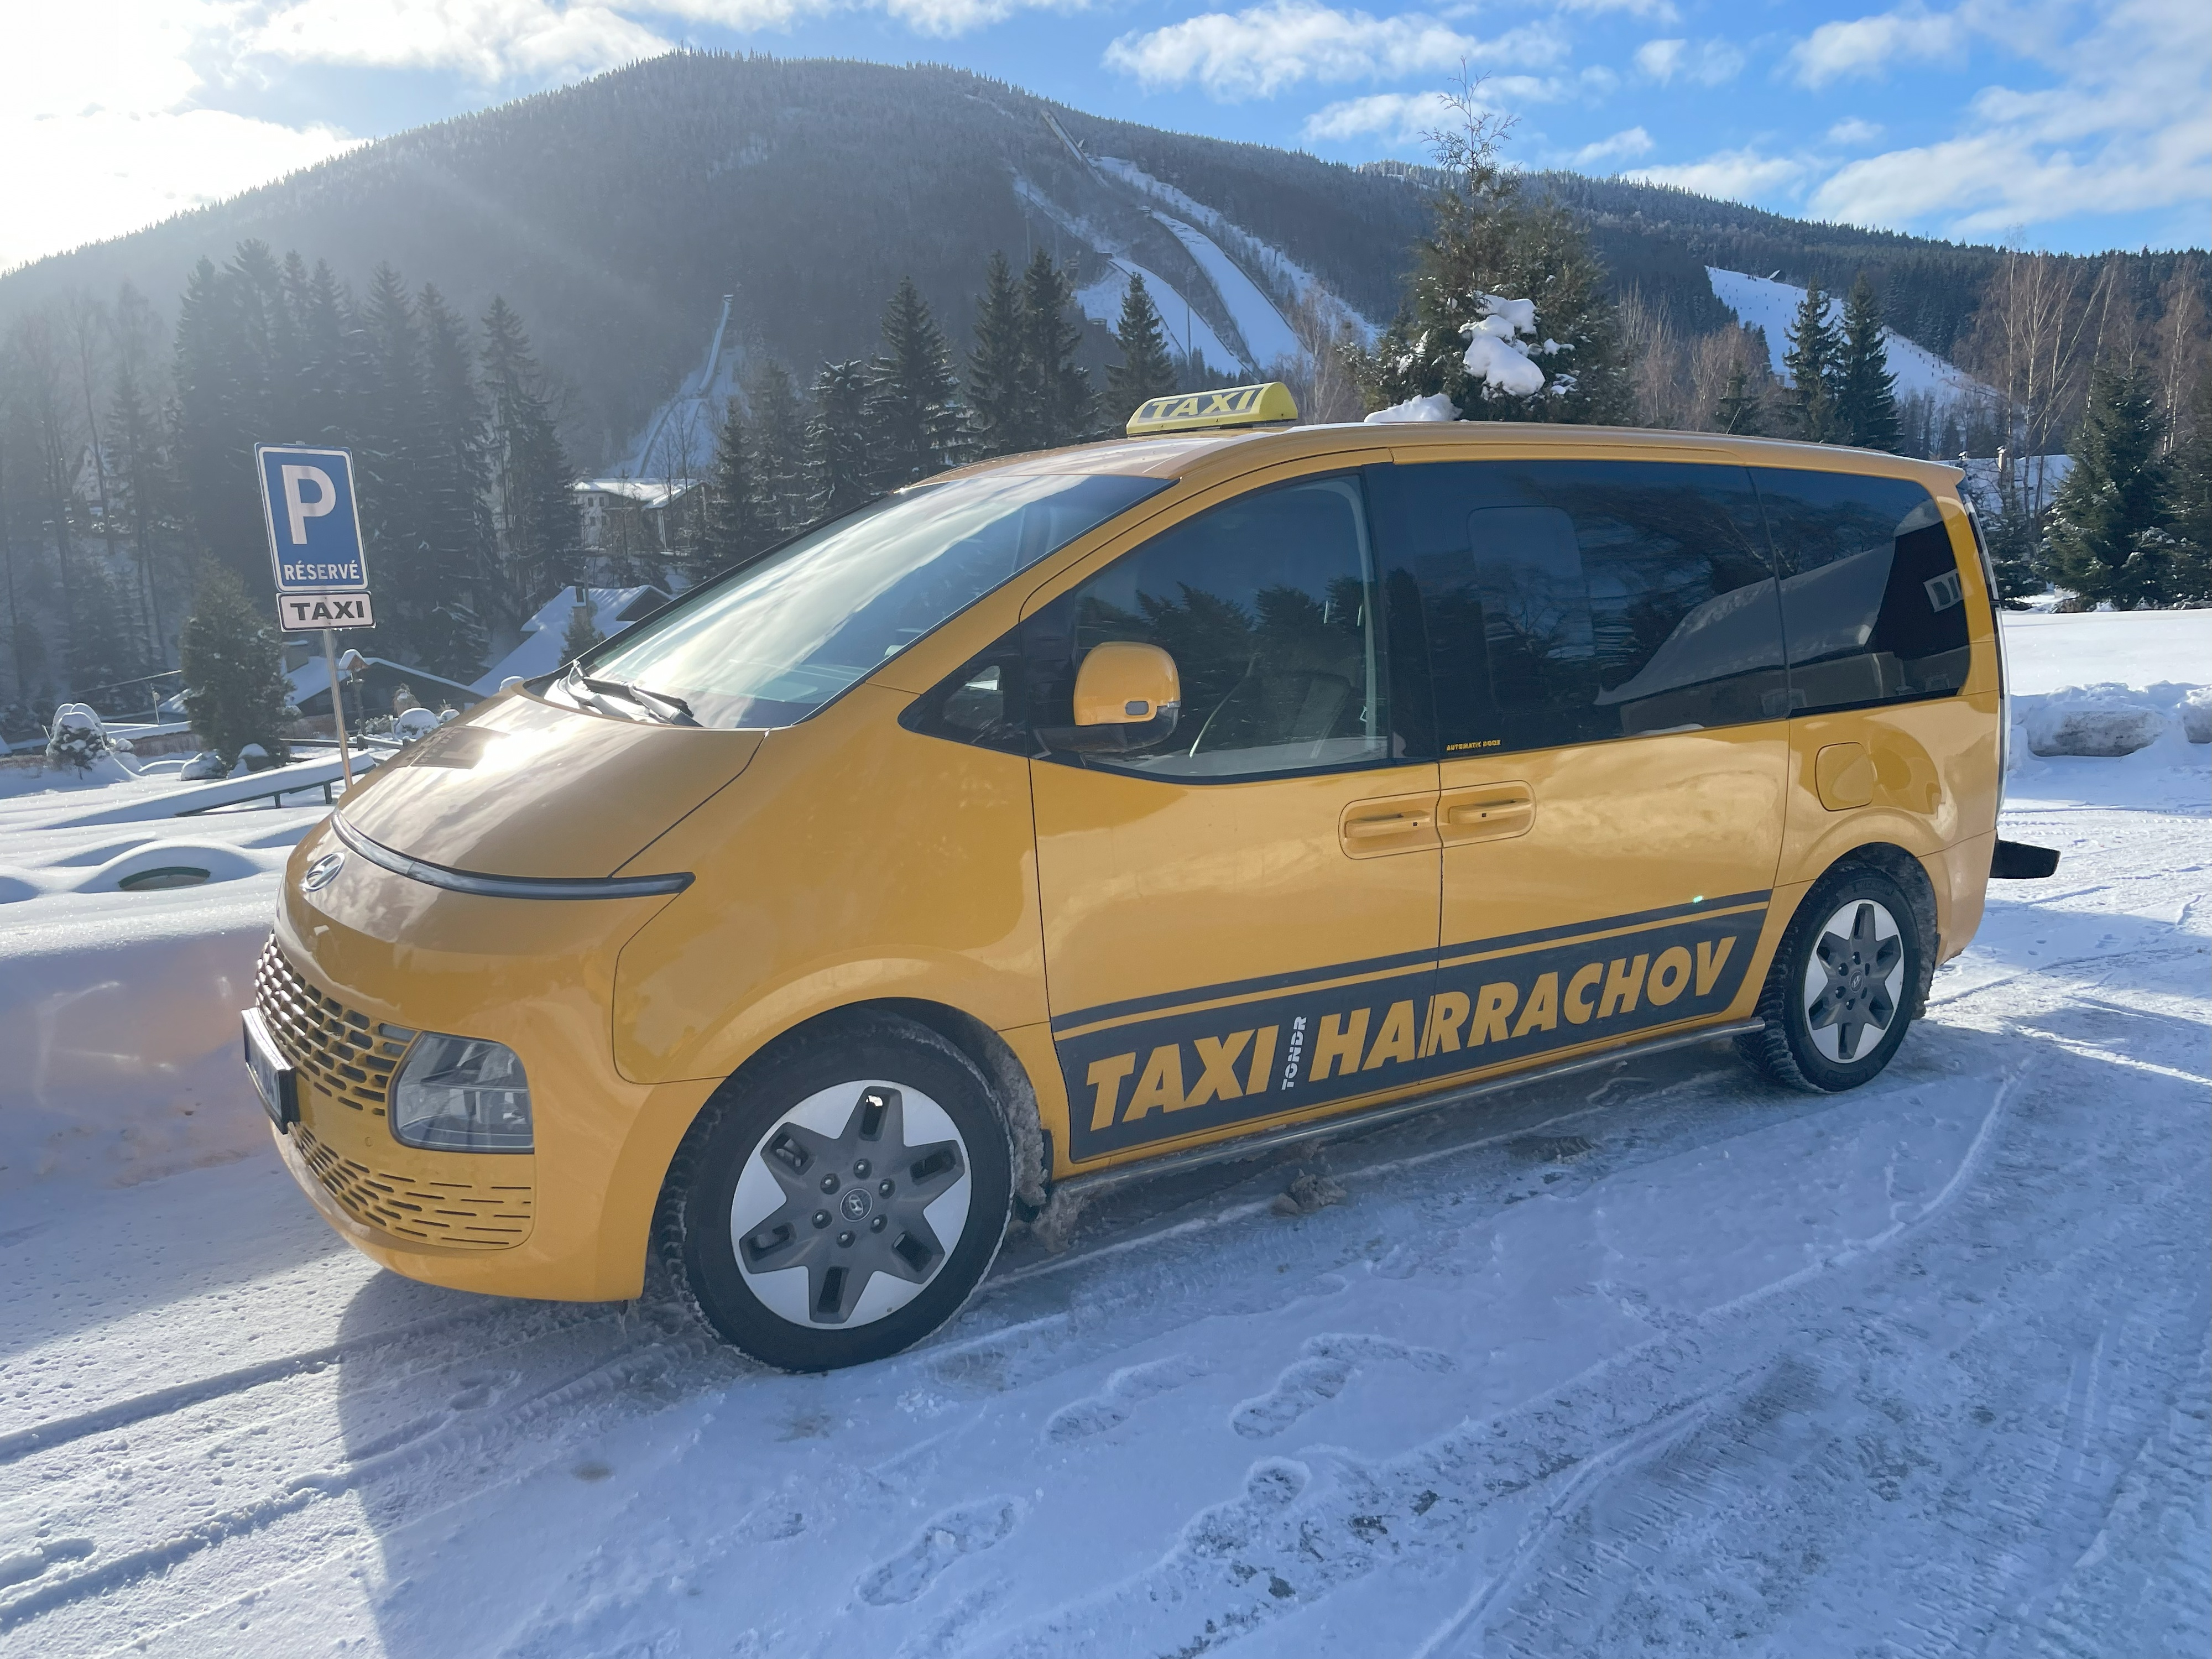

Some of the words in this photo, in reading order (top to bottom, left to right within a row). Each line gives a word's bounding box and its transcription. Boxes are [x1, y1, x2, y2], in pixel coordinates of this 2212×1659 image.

[1151, 389, 1256, 419] TAXI
[281, 464, 336, 545] P
[283, 560, 360, 581] RÉSERVÉ
[290, 601, 365, 621] TAXI
[1446, 742, 1481, 751] AUTOMATIC
[1086, 1024, 1279, 1132] TAXI
[1308, 936, 1738, 1083] HARRACHOV
[1281, 1016, 1307, 1091] TONDR
